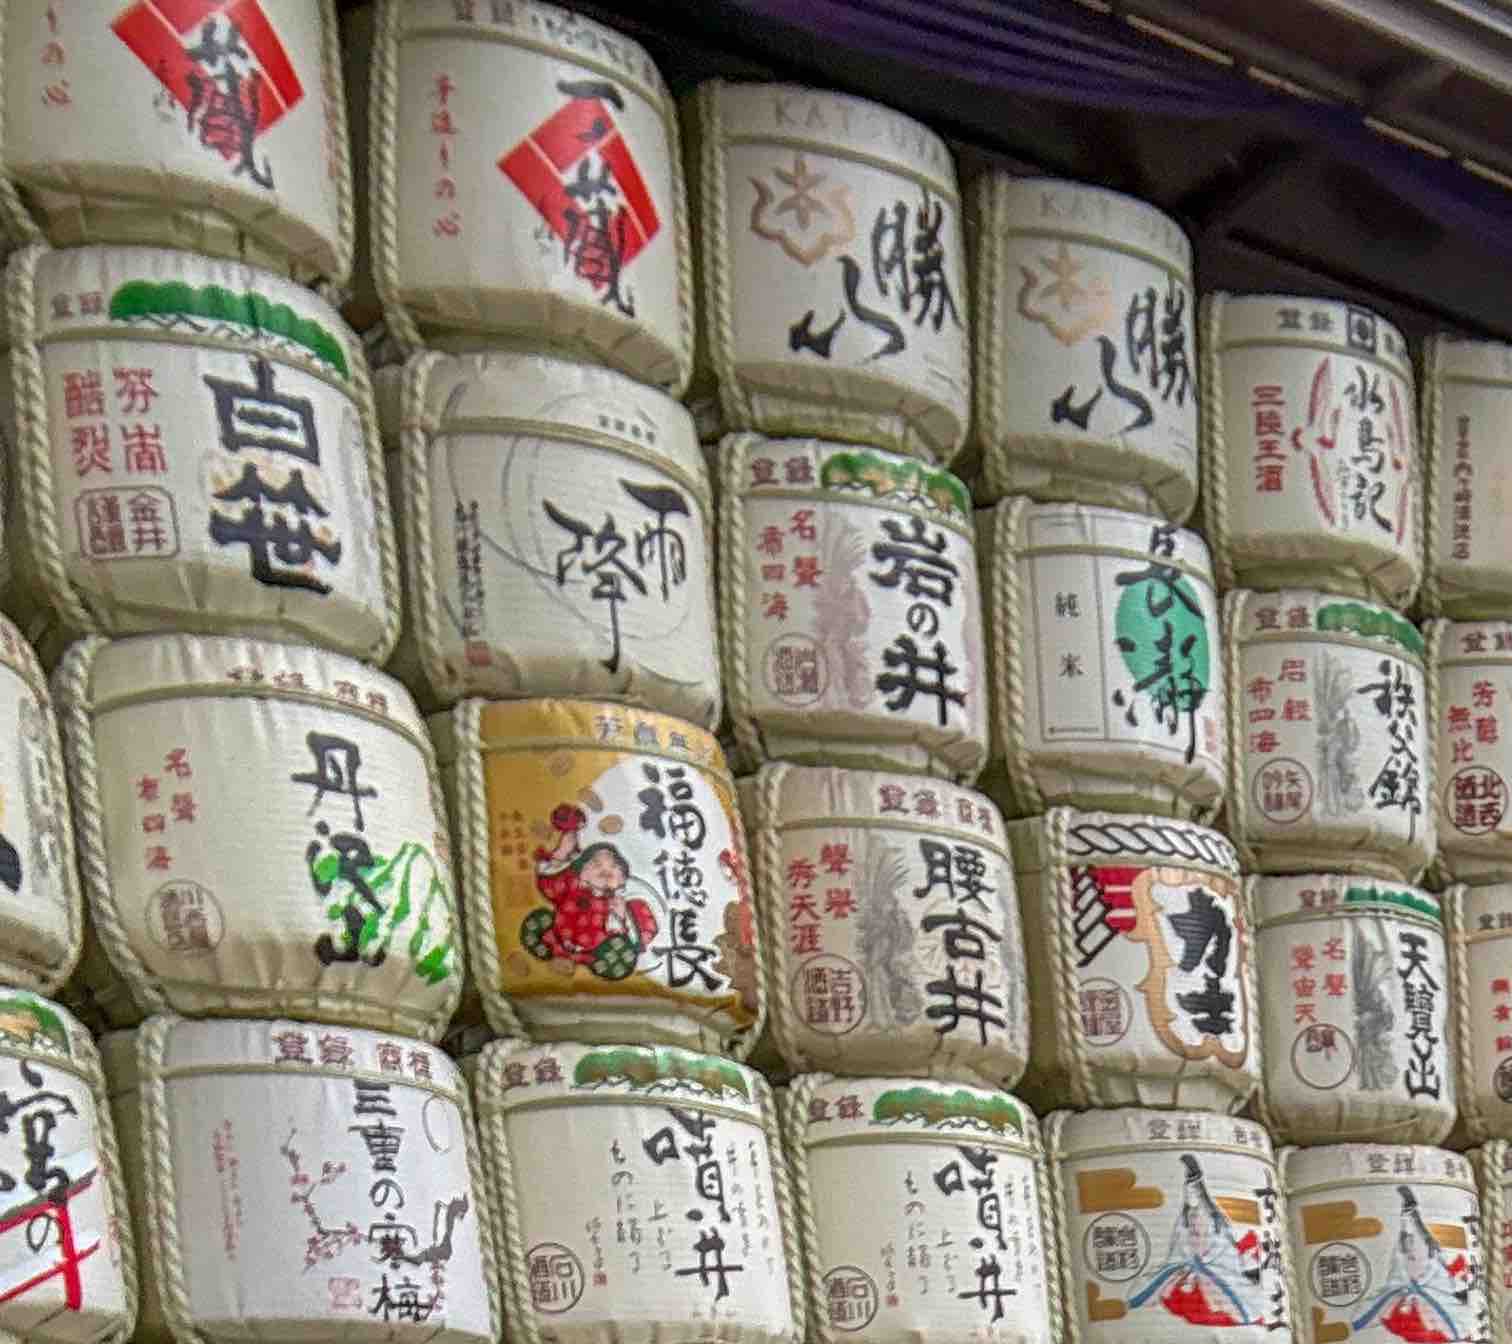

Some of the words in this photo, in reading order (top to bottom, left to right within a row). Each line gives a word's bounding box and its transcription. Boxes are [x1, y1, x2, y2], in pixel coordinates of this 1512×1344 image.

[789, 186, 960, 360] 勝山
[870, 514, 967, 727] 岩の井
[1055, 590, 1084, 679] 純米
[912, 837, 1008, 1046] 腰古井
[1166, 886, 1236, 1035] 力士
[349, 1079, 433, 1323] 三重の寒梅
